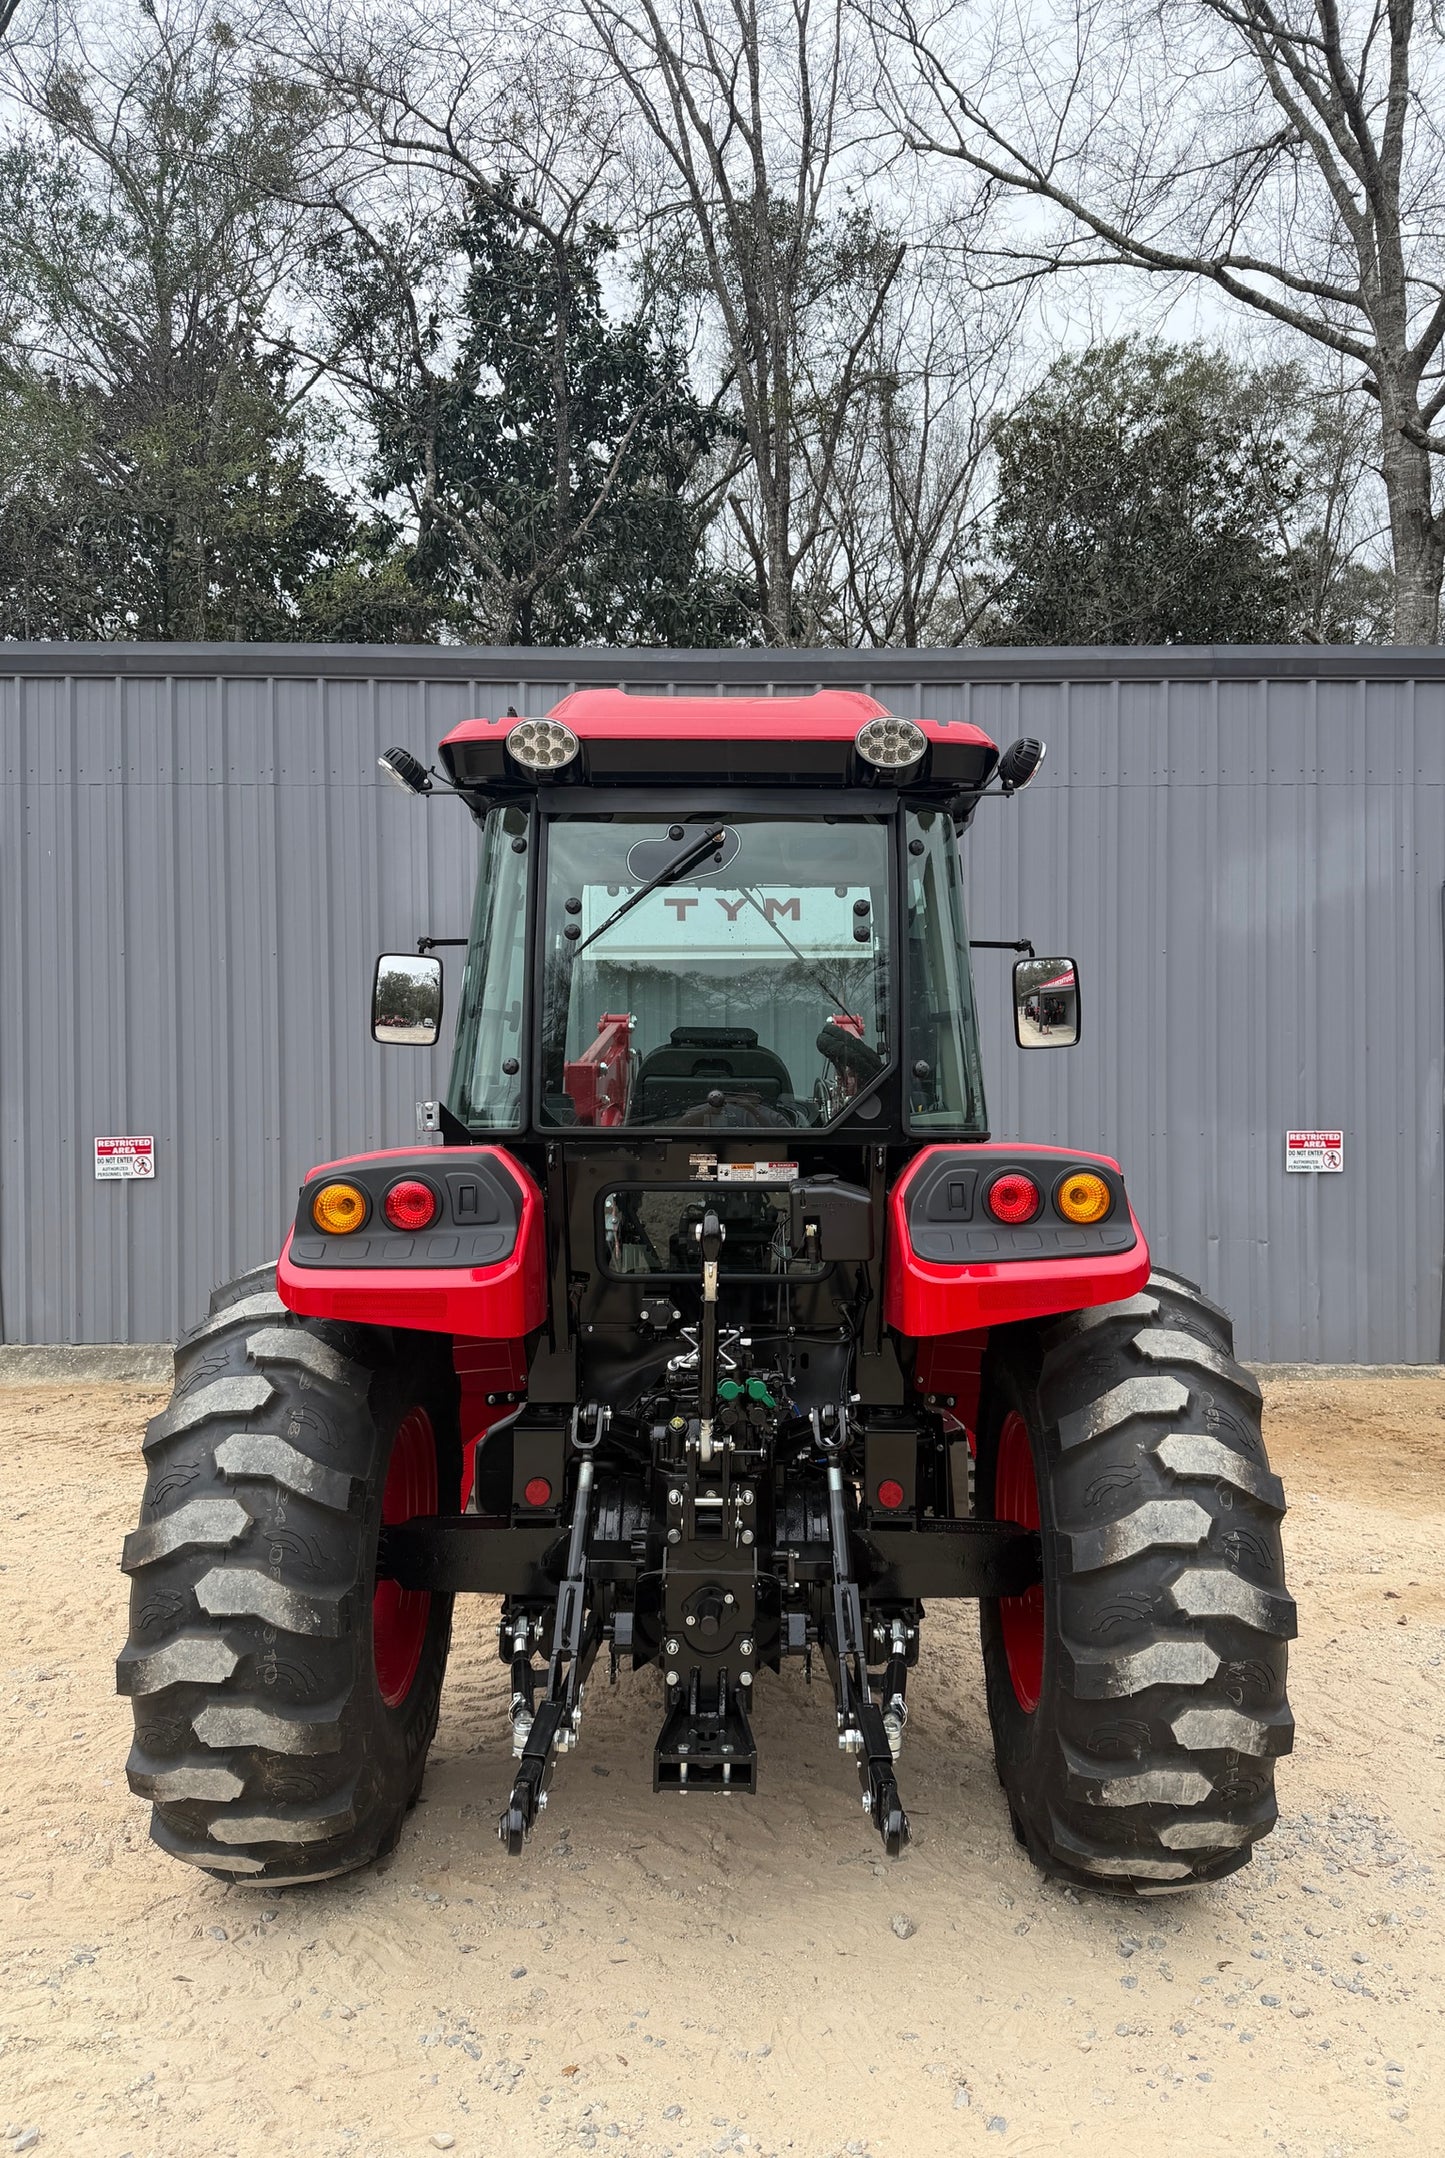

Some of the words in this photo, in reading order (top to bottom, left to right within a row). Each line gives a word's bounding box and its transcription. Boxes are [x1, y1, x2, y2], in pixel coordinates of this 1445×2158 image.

[663, 897, 801, 922] TYM
[98, 1139, 151, 1147] RESTRICTED
[116, 1156, 133, 1164] ENTER
